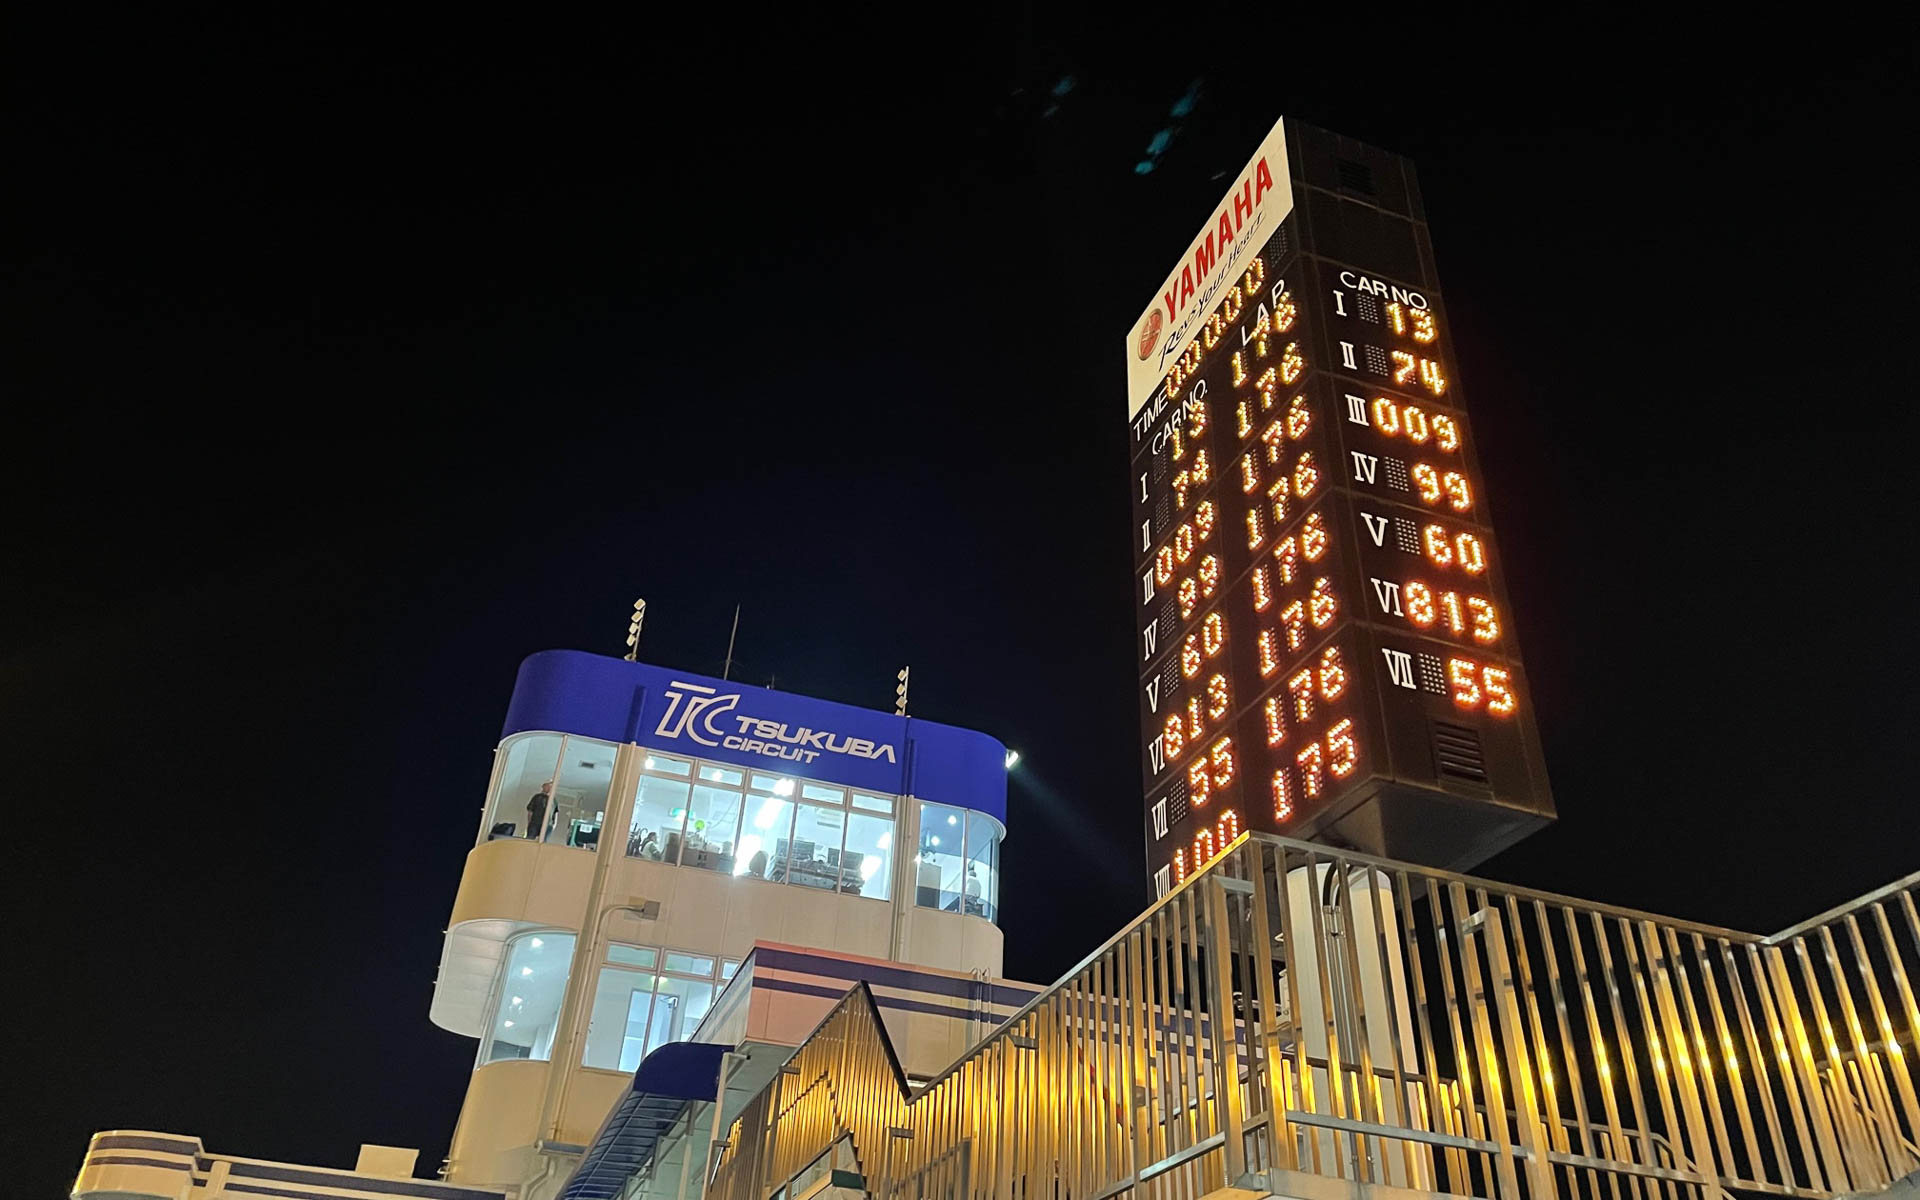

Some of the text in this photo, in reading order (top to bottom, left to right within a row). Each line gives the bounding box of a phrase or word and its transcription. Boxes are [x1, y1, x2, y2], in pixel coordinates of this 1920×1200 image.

[1164, 155, 1273, 324] YAMAHA
[1158, 209, 1264, 372] Revs Your Heart
[1241, 279, 1284, 346] LAP
[1340, 271, 1389, 299] CAR
[1387, 302, 1435, 342] 13
[1173, 400, 1206, 461] 13
[1232, 291, 1297, 387] 176
[1391, 350, 1446, 395] 74
[1133, 385, 1168, 441] TIME
[1152, 408, 1181, 455] CAR
[1172, 449, 1210, 510] 74
[1236, 342, 1304, 438] 176
[1372, 398, 1459, 450] 009
[1155, 501, 1214, 585] 009
[1241, 396, 1310, 493] 176
[1413, 463, 1470, 509] 99
[1178, 554, 1218, 619] 99
[1246, 452, 1318, 550] 176
[1424, 524, 1485, 573] 60
[1182, 612, 1223, 676] 60
[1252, 513, 1327, 611] 176
[1405, 581, 1498, 640] 813
[1164, 674, 1228, 758] 813
[1258, 577, 1335, 676] 176
[1450, 658, 1514, 712] 55
[722, 735, 821, 764] CIRCUIT
[735, 715, 896, 764] TSUKUBA
[1189, 736, 1234, 805] 55
[1265, 647, 1345, 746] 176
[1272, 718, 1356, 821] 175
